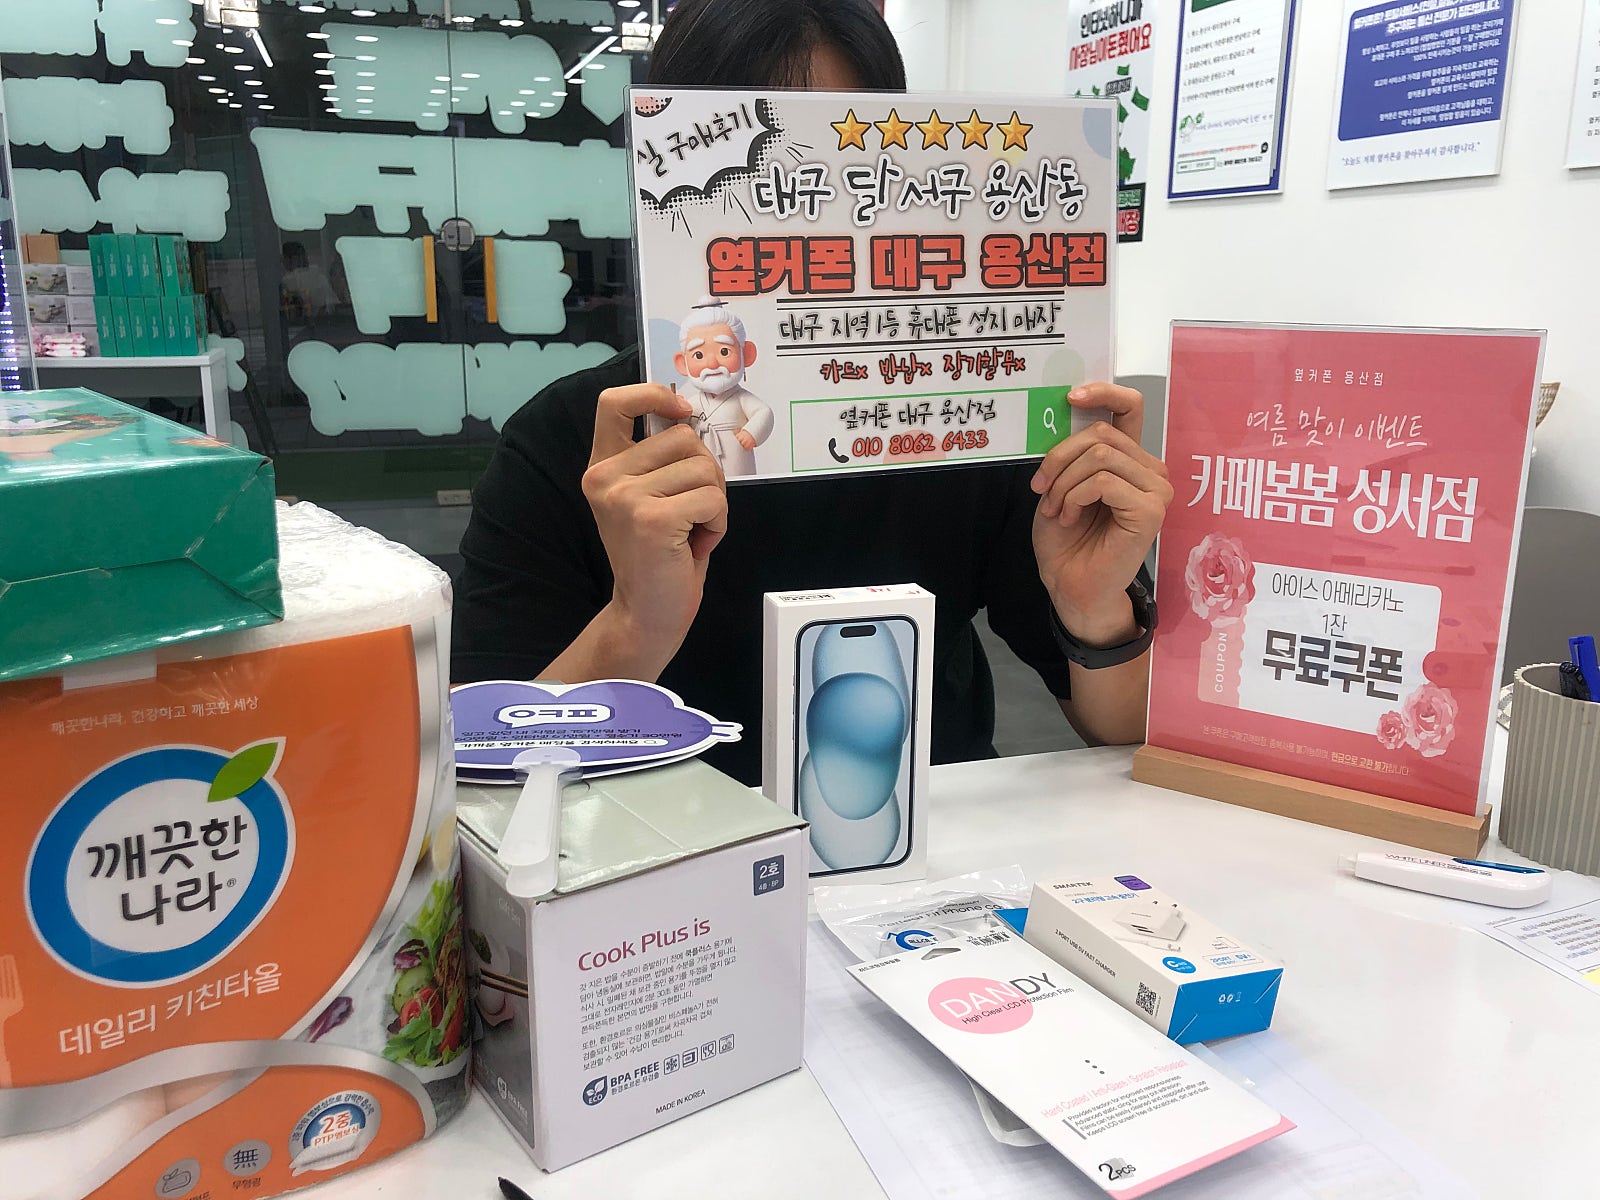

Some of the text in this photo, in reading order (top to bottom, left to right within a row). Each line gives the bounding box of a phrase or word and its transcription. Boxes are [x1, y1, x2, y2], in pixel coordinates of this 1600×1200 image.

[636, 104, 753, 178] 실 구매후기
[757, 167, 832, 215] 대구
[986, 159, 1085, 218] 용산동
[706, 232, 1107, 296] 옆커폰 대구 용산점
[778, 304, 1063, 342] 대구 지역 1등 휴대폰 성지 매장
[1294, 369, 1385, 387] 옆커폰 용산점
[839, 398, 998, 431] 옆커폰 대구 용산점
[1246, 403, 1429, 449] 여름 맞이 이벤트
[852, 428, 989, 458] 010 8062 6433
[1187, 453, 1480, 544] 카페봄봄 성서점
[1271, 571, 1405, 613] 아이스 아메리카노
[1321, 613, 1348, 639] 1잔
[1214, 631, 1227, 693] COUPON
[1261, 629, 1404, 702] 무료쿠폰
[131, 704, 188, 725] 건강하고
[191, 697, 231, 718] 깨끗한
[233, 694, 260, 712] 세상
[1331, 751, 1358, 767] 현금으로
[86, 814, 248, 882] 깨끗한
[1385, 853, 1418, 864] WHITE
[759, 861, 781, 880] 2호
[942, 904, 983, 916] Phone
[578, 917, 711, 972] Cook Plus is
[620, 967, 641, 980] 수분이
[596, 982, 623, 998] 냉동실에
[939, 972, 1057, 1019] DANDY
[58, 961, 283, 1056] 데일리 키친타올
[581, 1011, 601, 1024] 그대로
[961, 986, 1075, 1026] High Clear LCD Protection Film
[610, 1061, 660, 1088] BPA FREE
[588, 1092, 603, 1105] ECO
[655, 1098, 676, 1115] MADE
[684, 1088, 706, 1102] KOREA
[321, 1110, 353, 1135] 2중
[232, 1148, 259, 1170] 無
